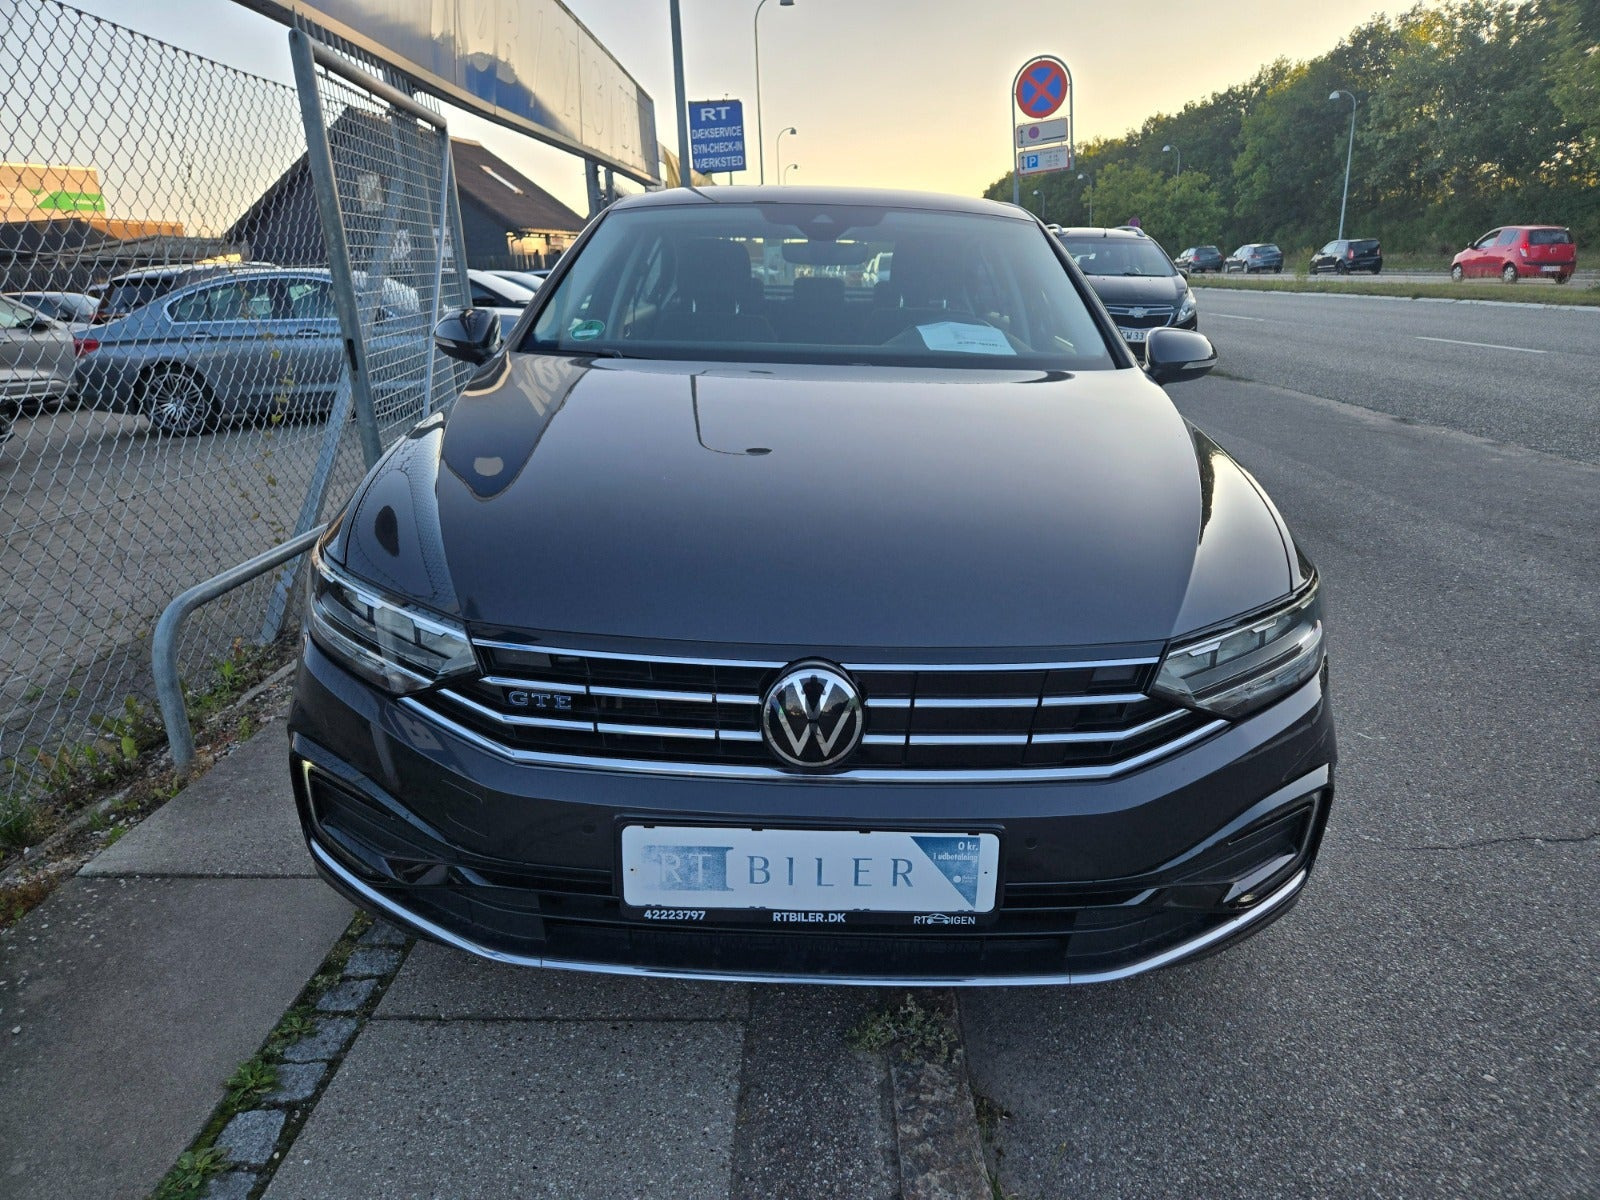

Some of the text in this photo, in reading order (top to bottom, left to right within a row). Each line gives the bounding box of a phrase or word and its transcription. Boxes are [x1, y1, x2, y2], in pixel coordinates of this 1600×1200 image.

[700, 106, 731, 121] RT
[692, 126, 742, 140] DÆKSERVICE
[693, 141, 743, 155] SYN-CHECK-IN
[694, 156, 744, 169] VÆRKSTED
[1029, 156, 1037, 167] P
[508, 690, 572, 710] GTE
[765, 670, 862, 767] VW
[957, 841, 979, 851] 0 kr.
[660, 852, 914, 887] RT BILER
[643, 909, 706, 921] 42223797
[772, 911, 846, 923] RTBILER.DK
